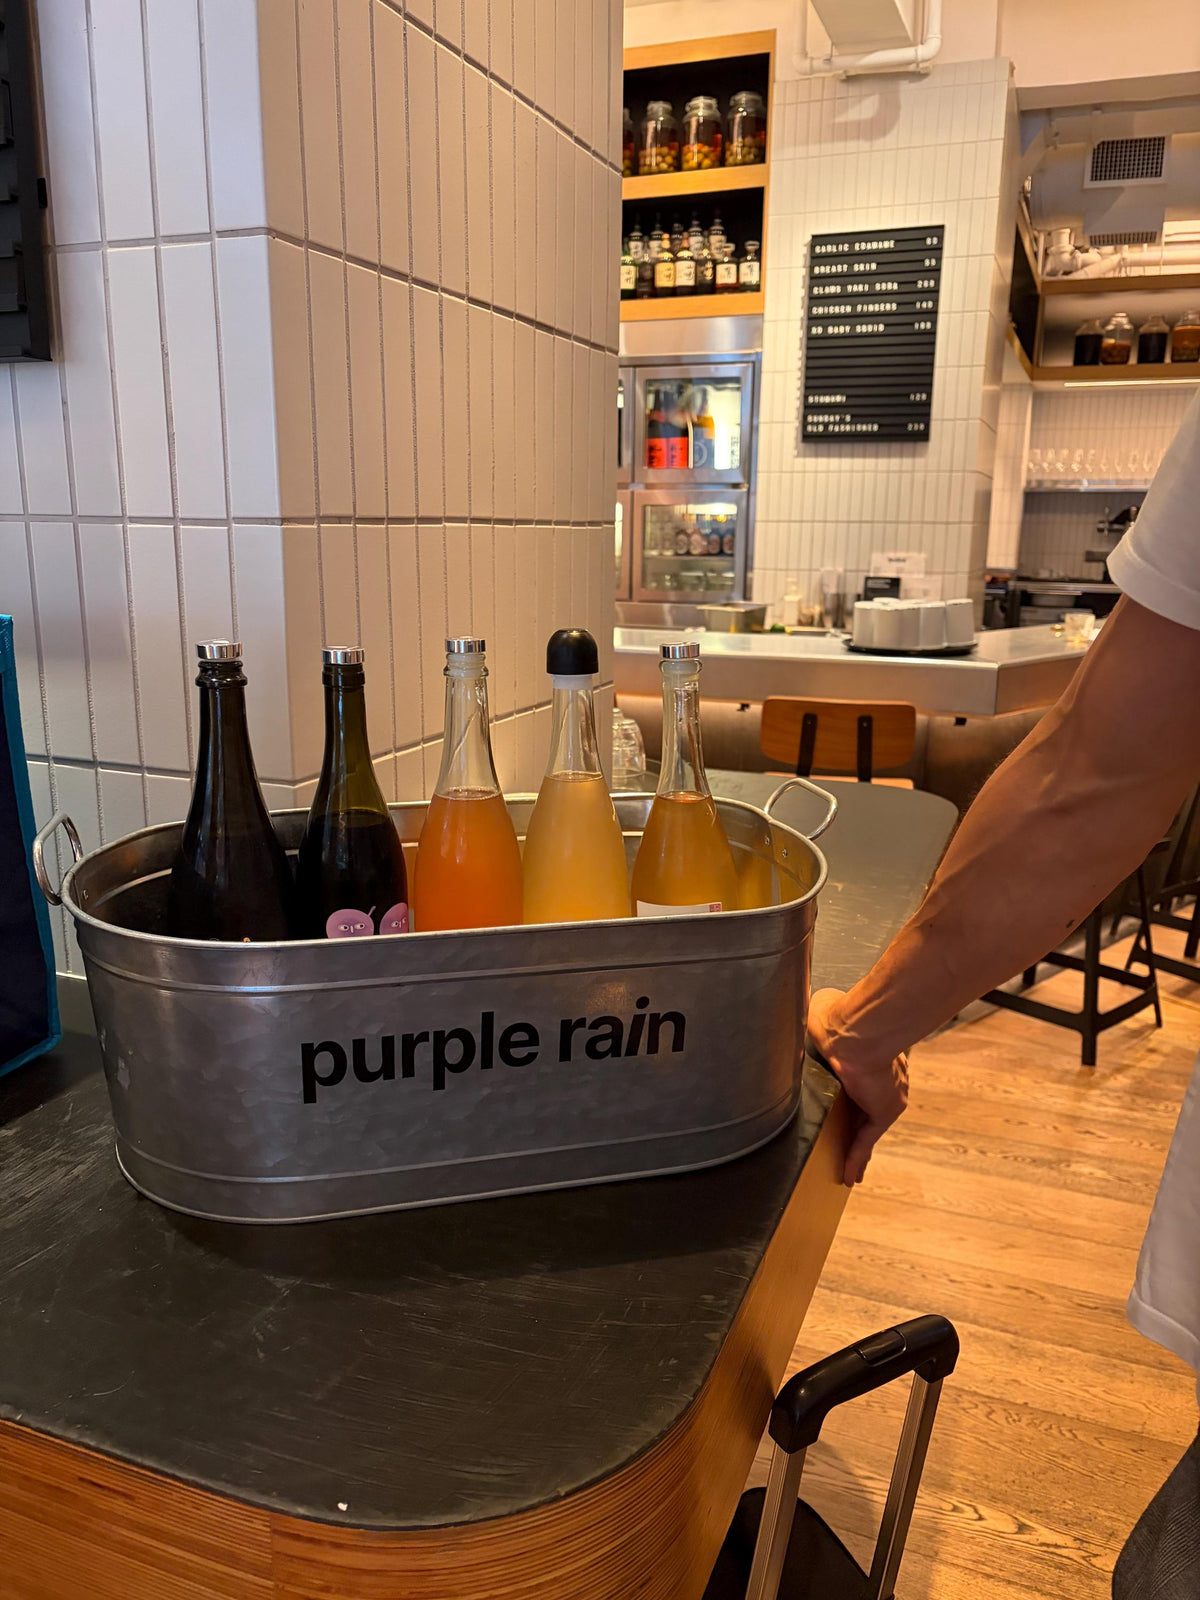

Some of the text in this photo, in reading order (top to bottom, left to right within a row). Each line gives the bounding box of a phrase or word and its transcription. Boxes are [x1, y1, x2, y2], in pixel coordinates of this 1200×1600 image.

[814, 263, 848, 274] BREAST
[853, 262, 877, 272] SKIN
[812, 305, 852, 315] CHICKEN
[856, 302, 897, 312] FINGERS
[301, 996, 686, 1104] purple rain
